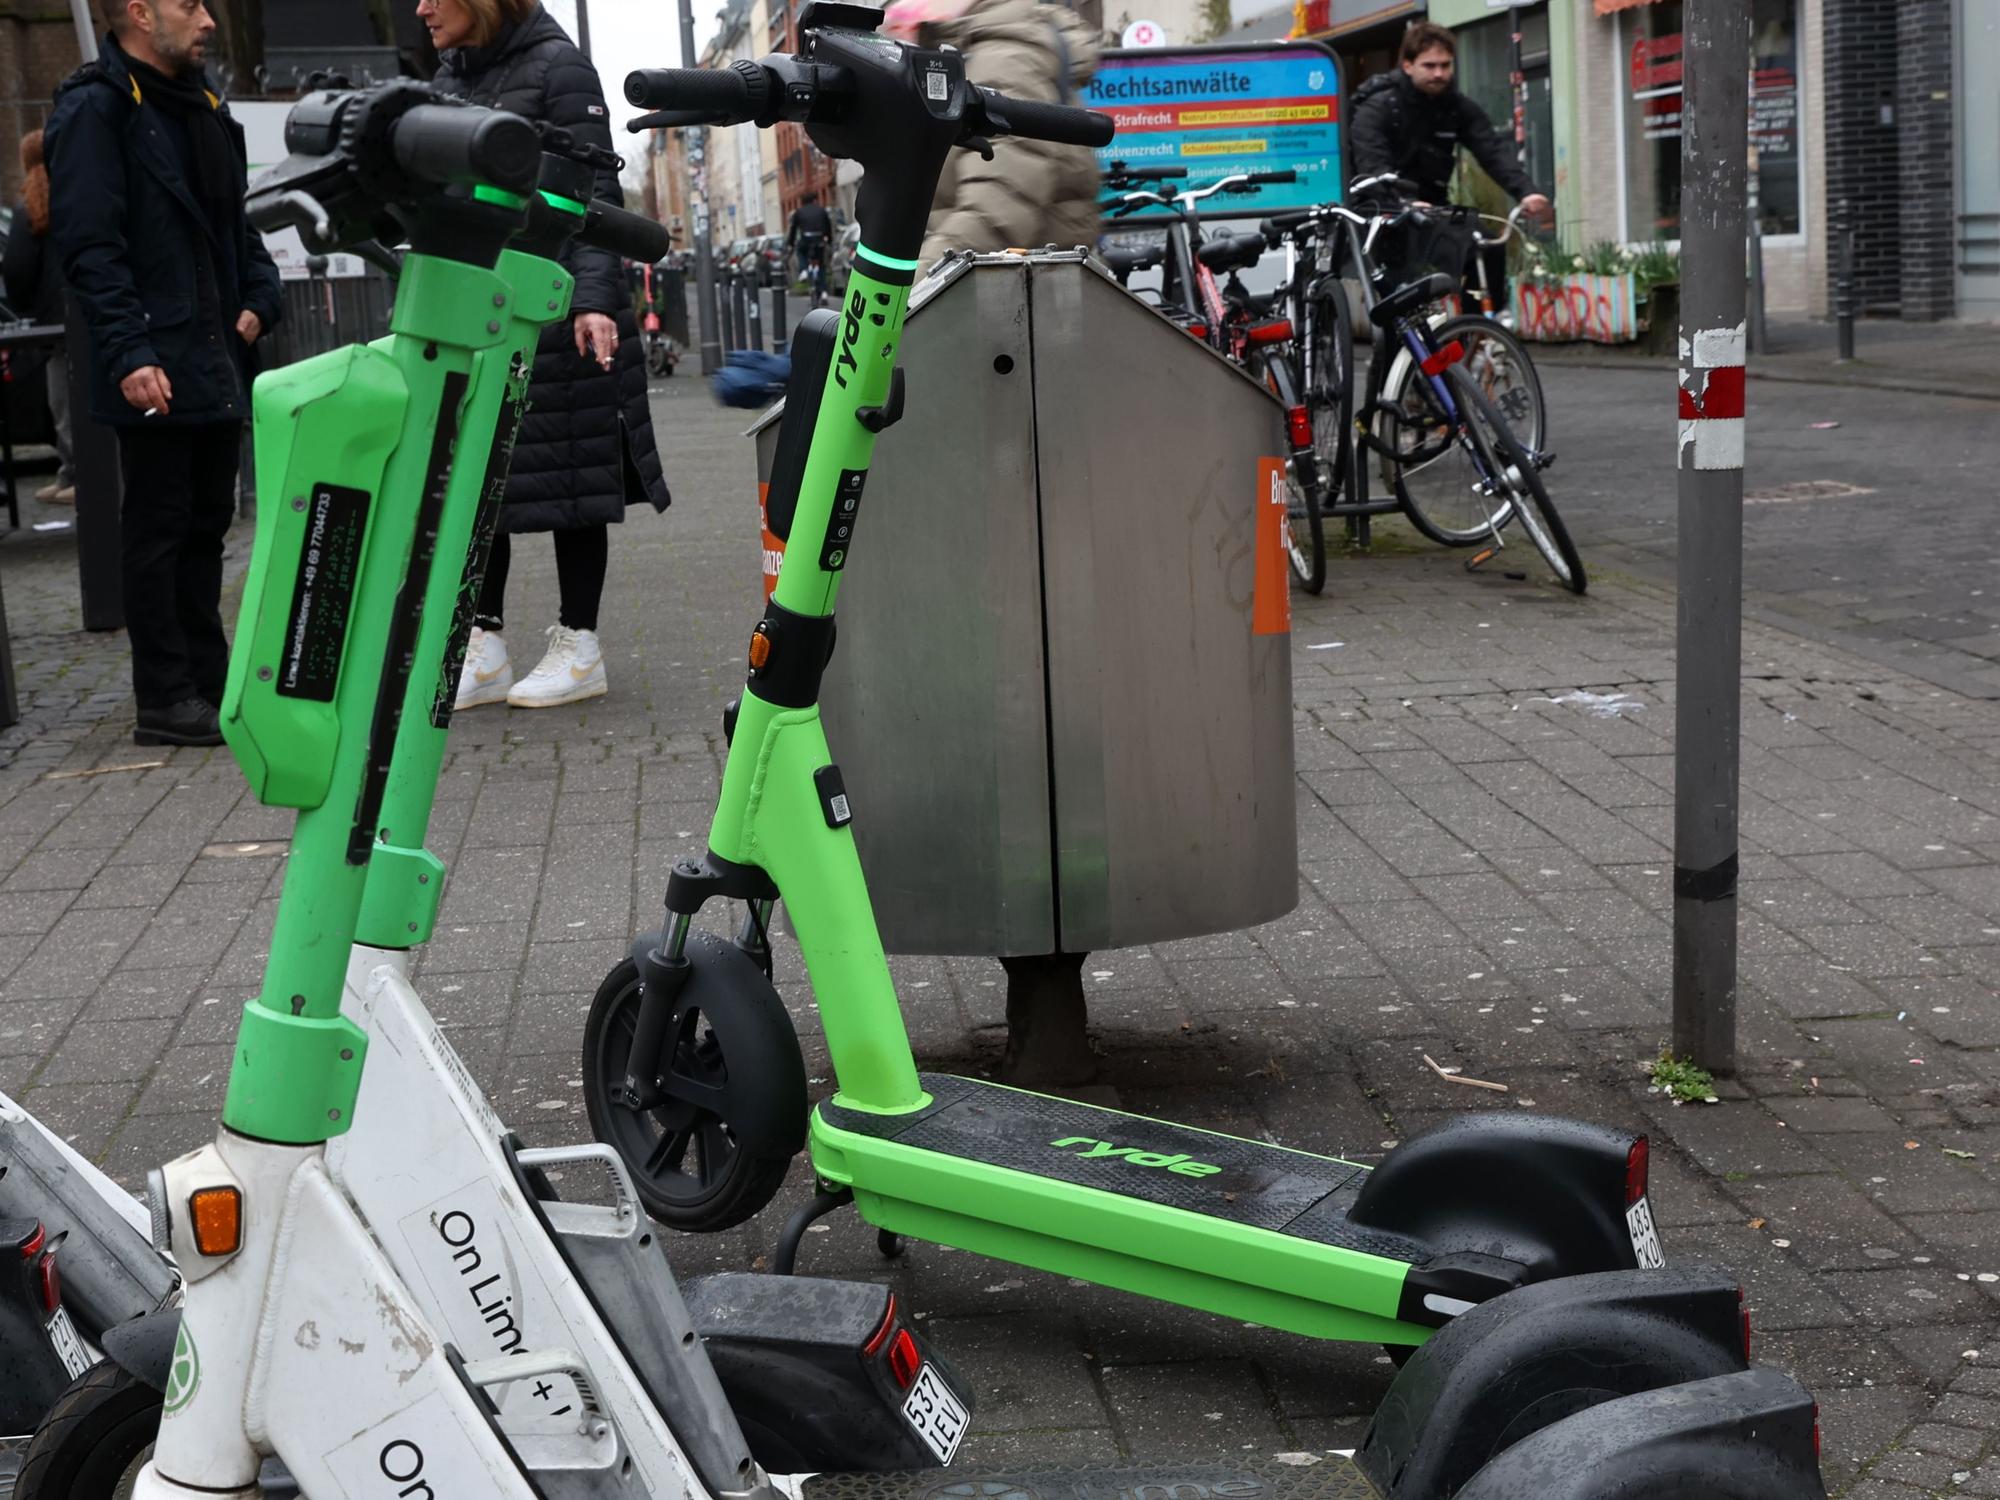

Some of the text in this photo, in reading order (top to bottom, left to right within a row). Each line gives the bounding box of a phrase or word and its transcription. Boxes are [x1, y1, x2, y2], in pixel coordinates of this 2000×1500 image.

[1090, 71, 1251, 99] Rechtsanwälte
[1114, 112, 1172, 127] Strafrecht
[1094, 143, 1174, 158] nsolvenzrecht
[835, 289, 867, 390] ryde
[310, 492, 331, 548] 77044733
[305, 565, 317, 587] +49
[307, 549, 321, 566] 69
[1049, 1136, 1223, 1178] ryde
[440, 1210, 482, 1276] On
[1629, 1203, 1650, 1241] 483
[906, 1371, 939, 1429] 537
[929, 1398, 961, 1456] IEV
[379, 1439, 435, 1500] On
